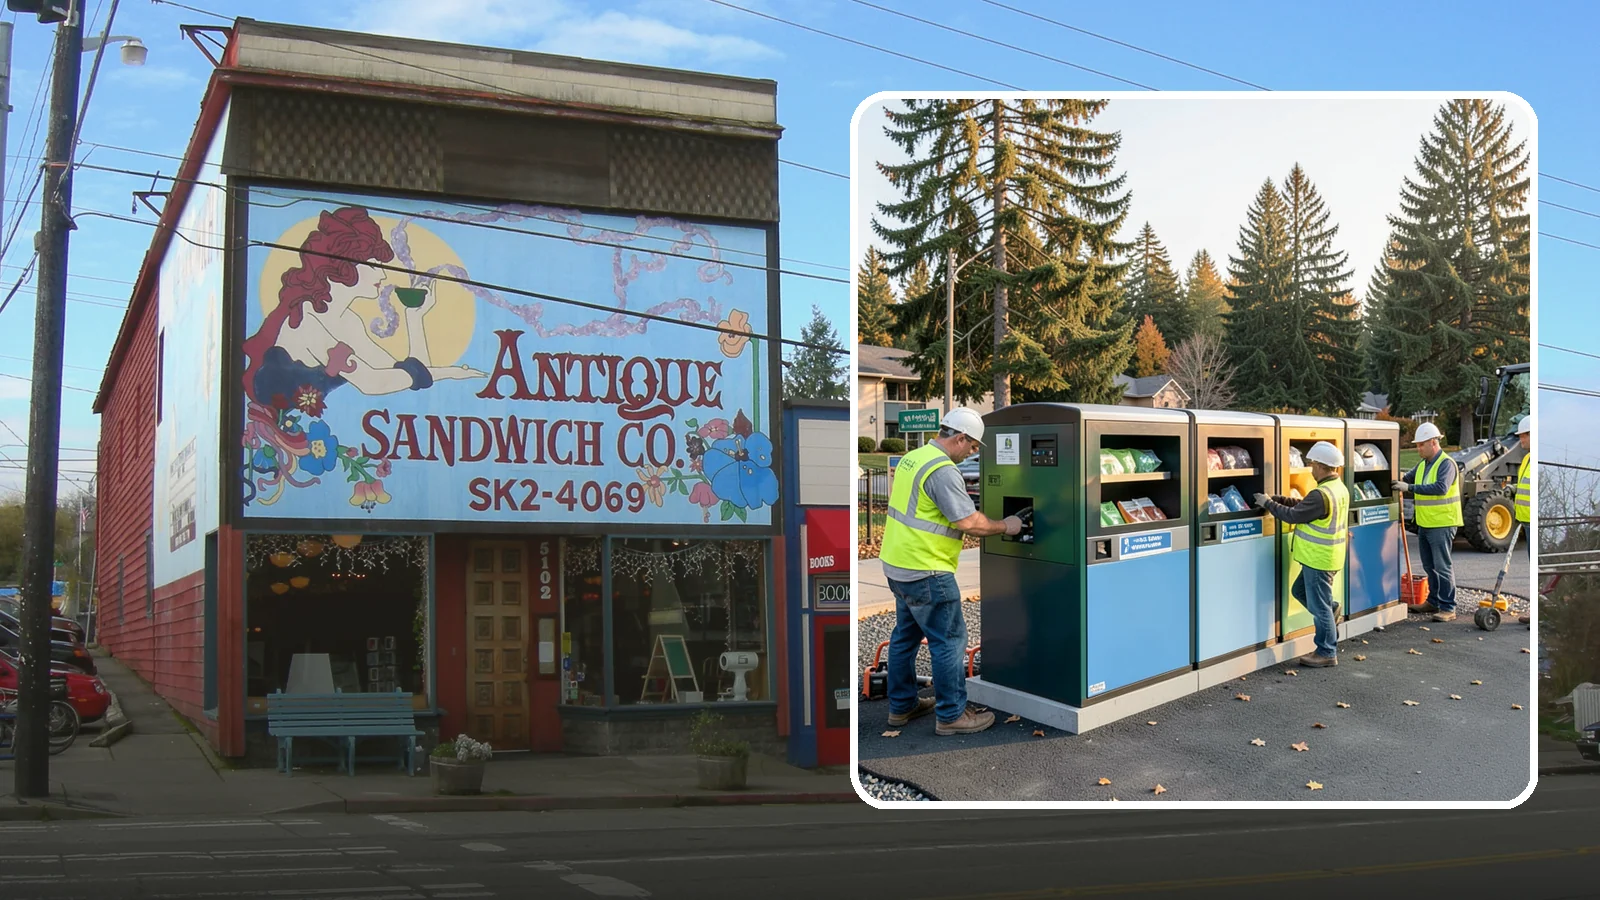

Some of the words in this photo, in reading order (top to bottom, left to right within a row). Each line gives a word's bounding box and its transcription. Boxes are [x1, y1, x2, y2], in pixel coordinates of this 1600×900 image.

[361, 408, 605, 467] SANDWICH
[617, 421, 685, 469] CO.
[468, 477, 646, 514] SK2-4069
[539, 541, 552, 600] 5102
[809, 555, 835, 569] BOOKS
